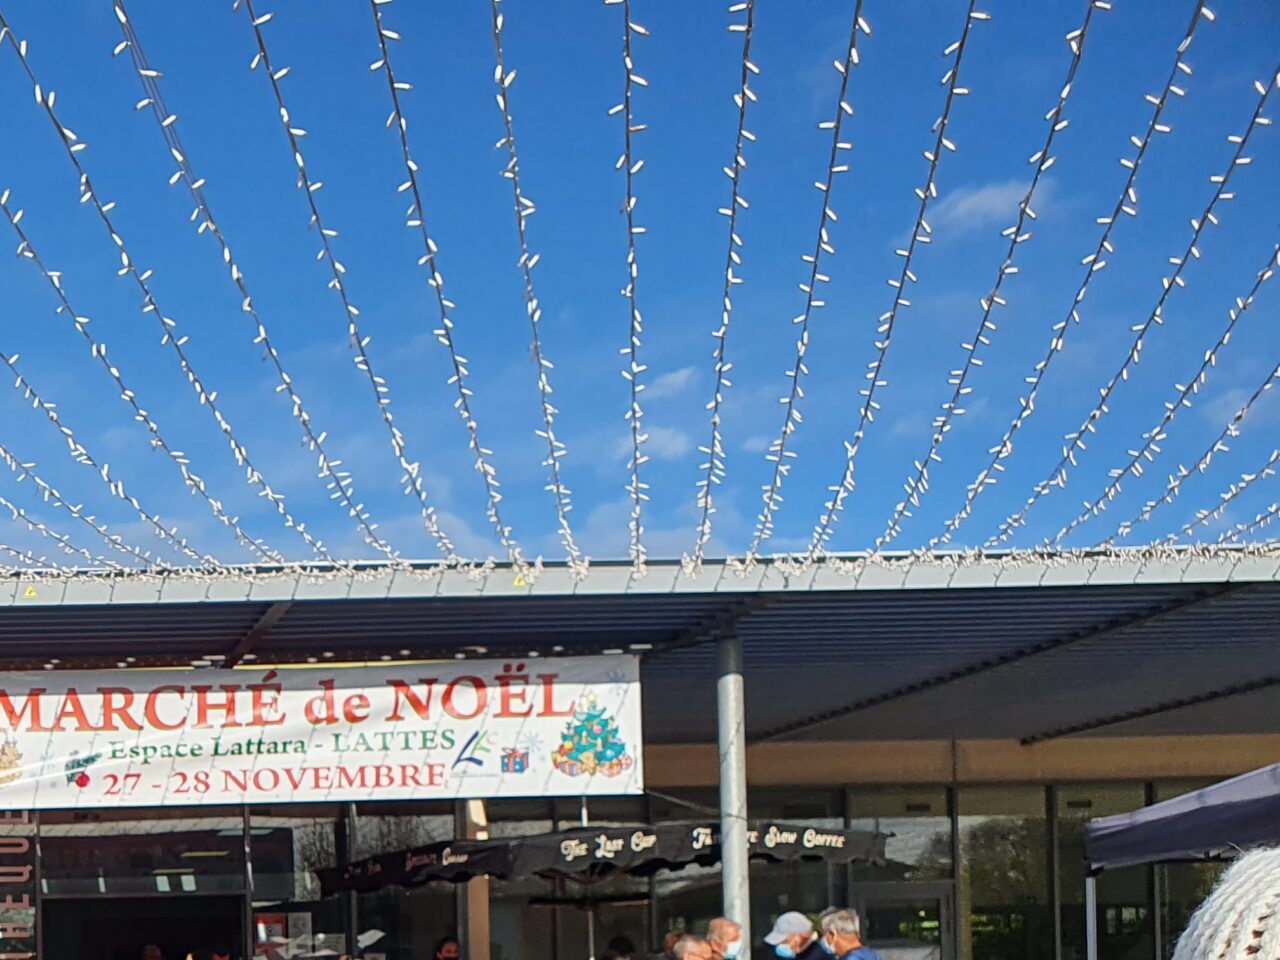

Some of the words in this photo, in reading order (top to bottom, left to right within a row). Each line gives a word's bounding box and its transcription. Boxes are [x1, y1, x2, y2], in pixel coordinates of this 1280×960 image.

[304, 678, 370, 726] de
[385, 663, 576, 722] NOËL
[108, 740, 203, 765] Espace
[210, 737, 307, 758] Lattara
[332, 729, 456, 752] LATTES
[102, 773, 142, 796] 27
[171, 770, 211, 794] 28
[221, 763, 447, 793] NOVEMBRE
